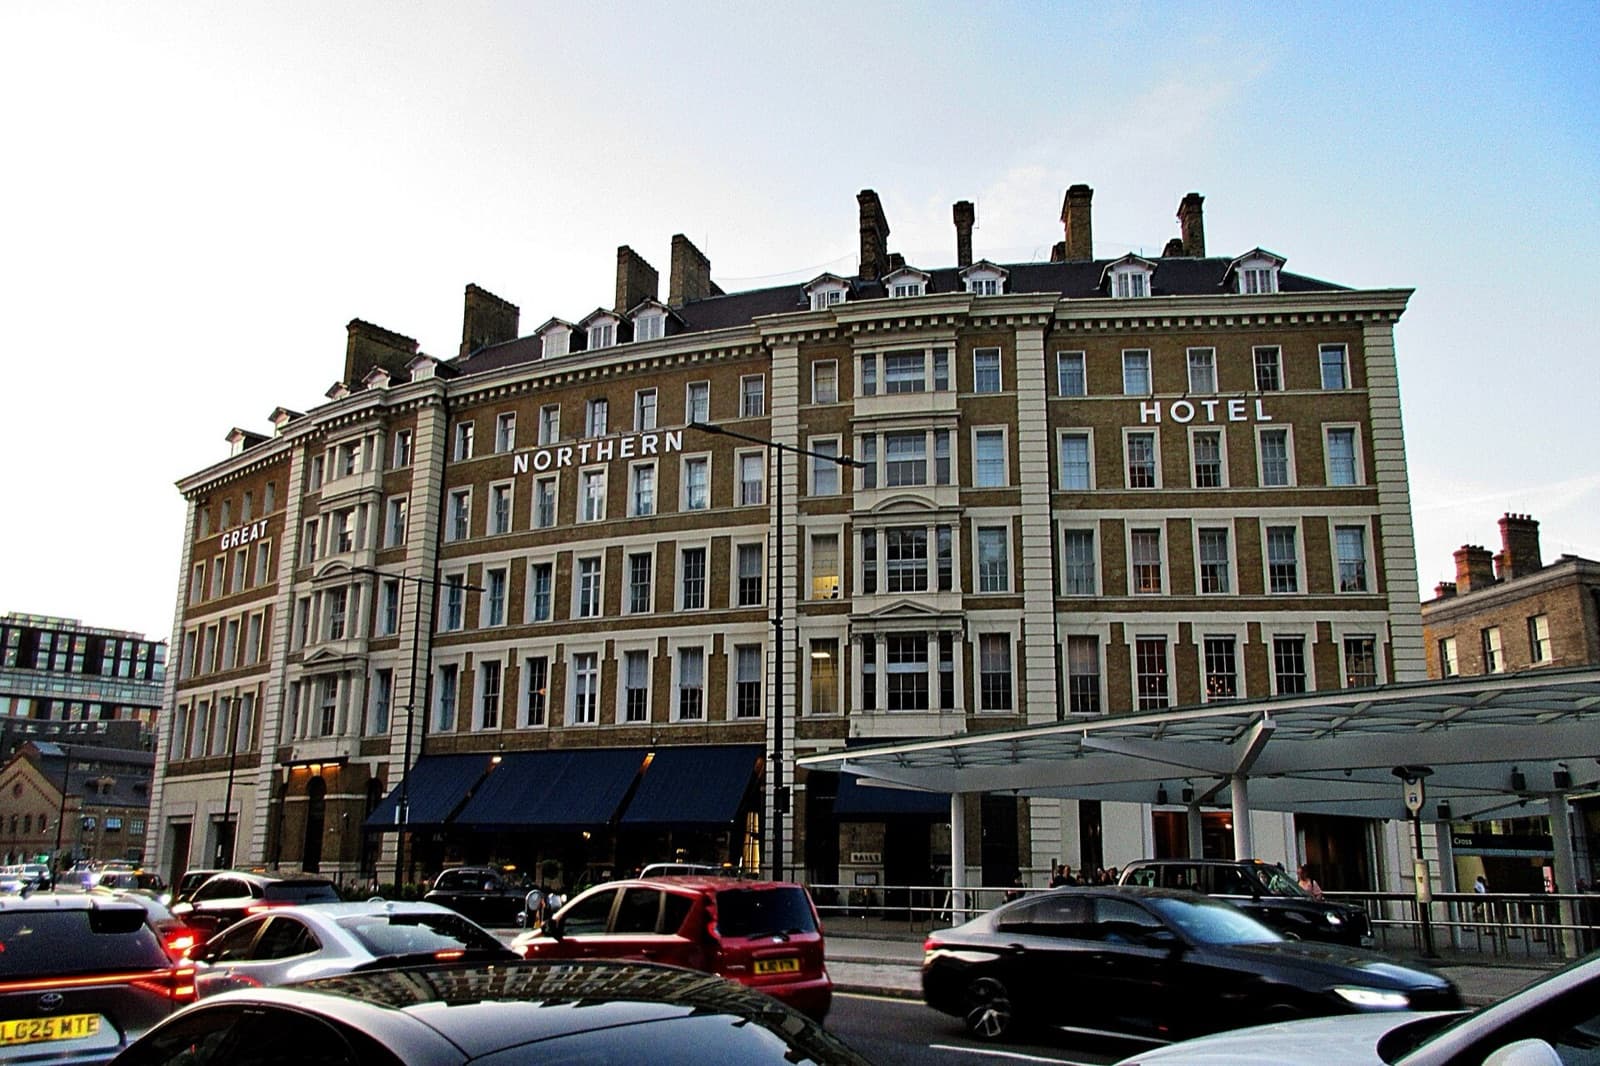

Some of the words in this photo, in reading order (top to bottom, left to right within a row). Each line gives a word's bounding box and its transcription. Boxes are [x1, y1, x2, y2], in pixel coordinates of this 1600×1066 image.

[221, 520, 268, 551] GREAT
[513, 431, 683, 475] NORTHERN
[1140, 399, 1273, 424] HOTEL
[1453, 837, 1473, 846] Cross
[0, 1020, 54, 1041] LG25
[60, 1015, 99, 1035] MTE
